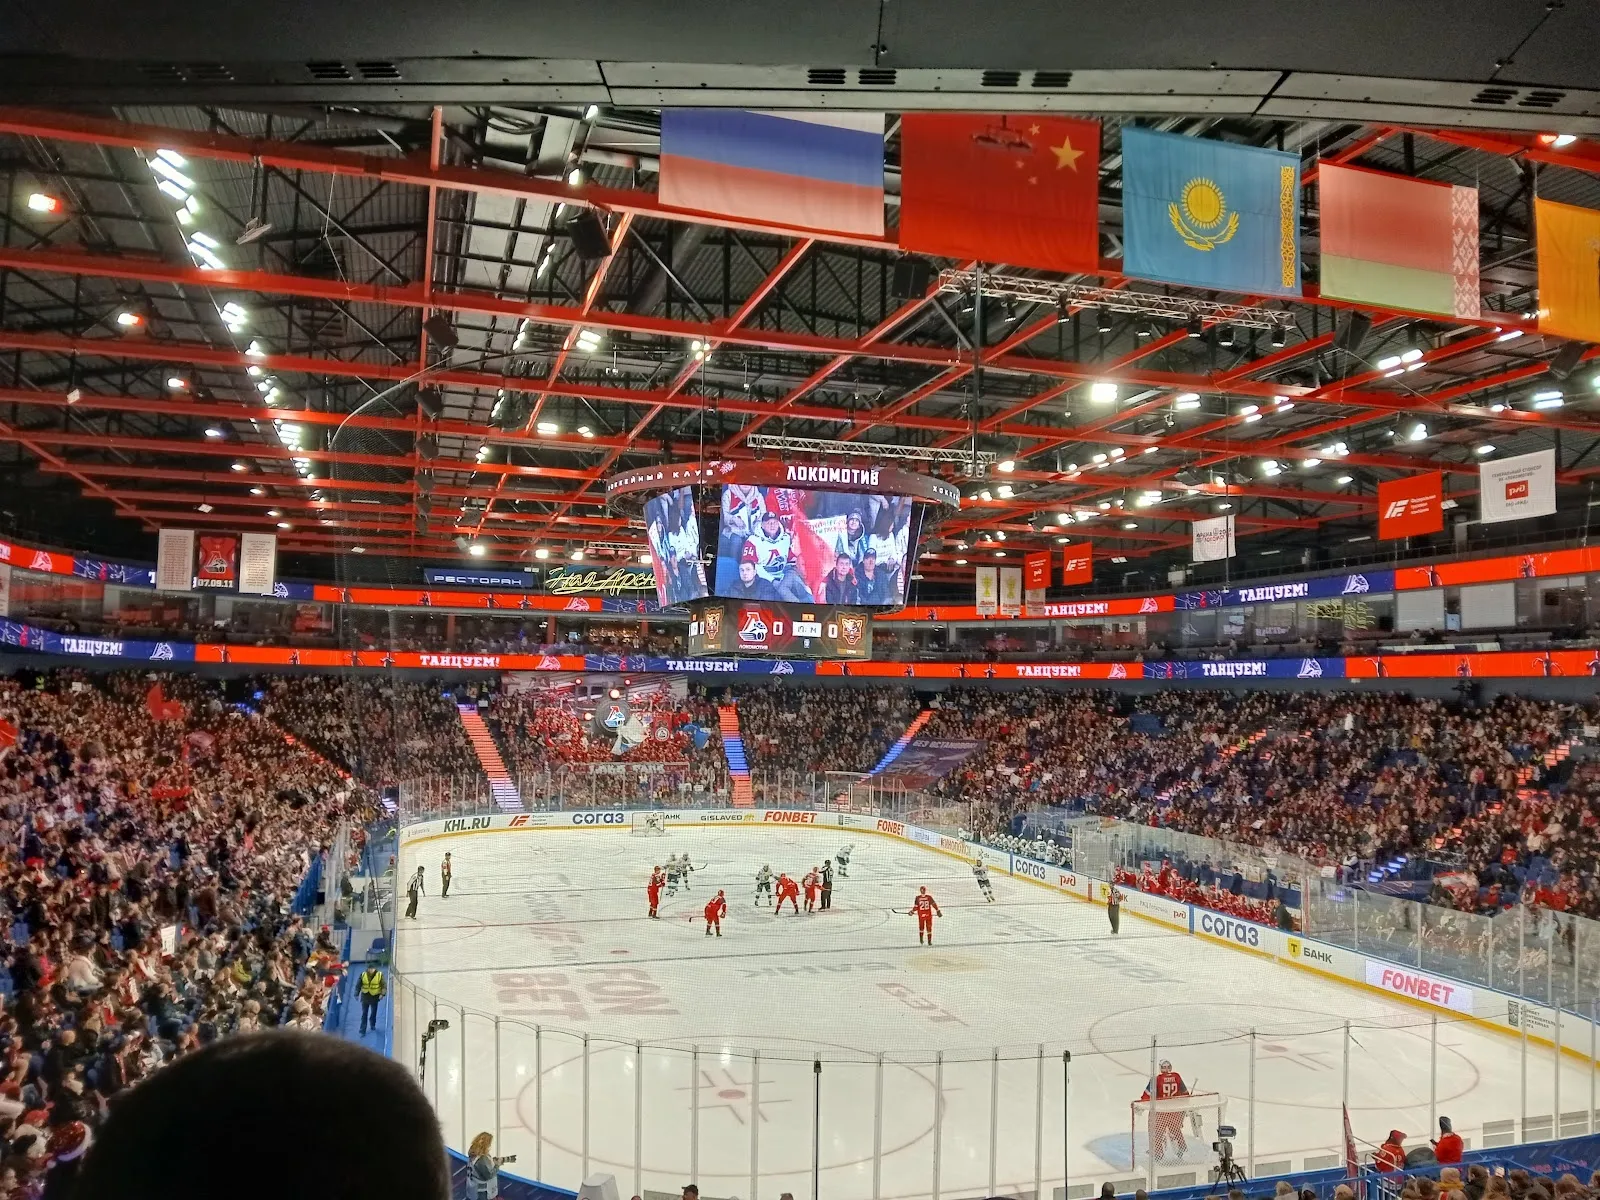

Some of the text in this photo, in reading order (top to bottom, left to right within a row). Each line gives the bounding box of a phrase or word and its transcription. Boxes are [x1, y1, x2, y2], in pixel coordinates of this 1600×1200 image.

[672, 469, 714, 478] КЛУБ
[786, 465, 880, 486] ЛОКОМОТИВ
[198, 578, 234, 588] 07.09.11
[434, 575, 522, 585] РЕСТОРАН
[595, 567, 657, 596] Арен
[1239, 583, 1309, 602] ТАНЦУЕМ!
[1044, 602, 1108, 616] ТАНЦУЕМ!
[772, 621, 783, 635] 0
[828, 623, 838, 638] 0
[60, 637, 123, 657] ТАНЦУЕМ!
[419, 654, 500, 668] ТАНЦУЕМ!
[665, 660, 739, 673] ТАНЦУЕМ!
[1016, 665, 1081, 679] ТАНЦУЕМ!
[1202, 662, 1267, 678] ТАНЦУЕМ!
[443, 816, 491, 832] KHL.RU
[763, 811, 817, 823] FONBET
[876, 819, 905, 836] FONBET
[919, 900, 930, 911] 28
[1303, 946, 1333, 964] БАНК
[1381, 969, 1455, 1005] FONBET
[1162, 1082, 1178, 1098] 92
